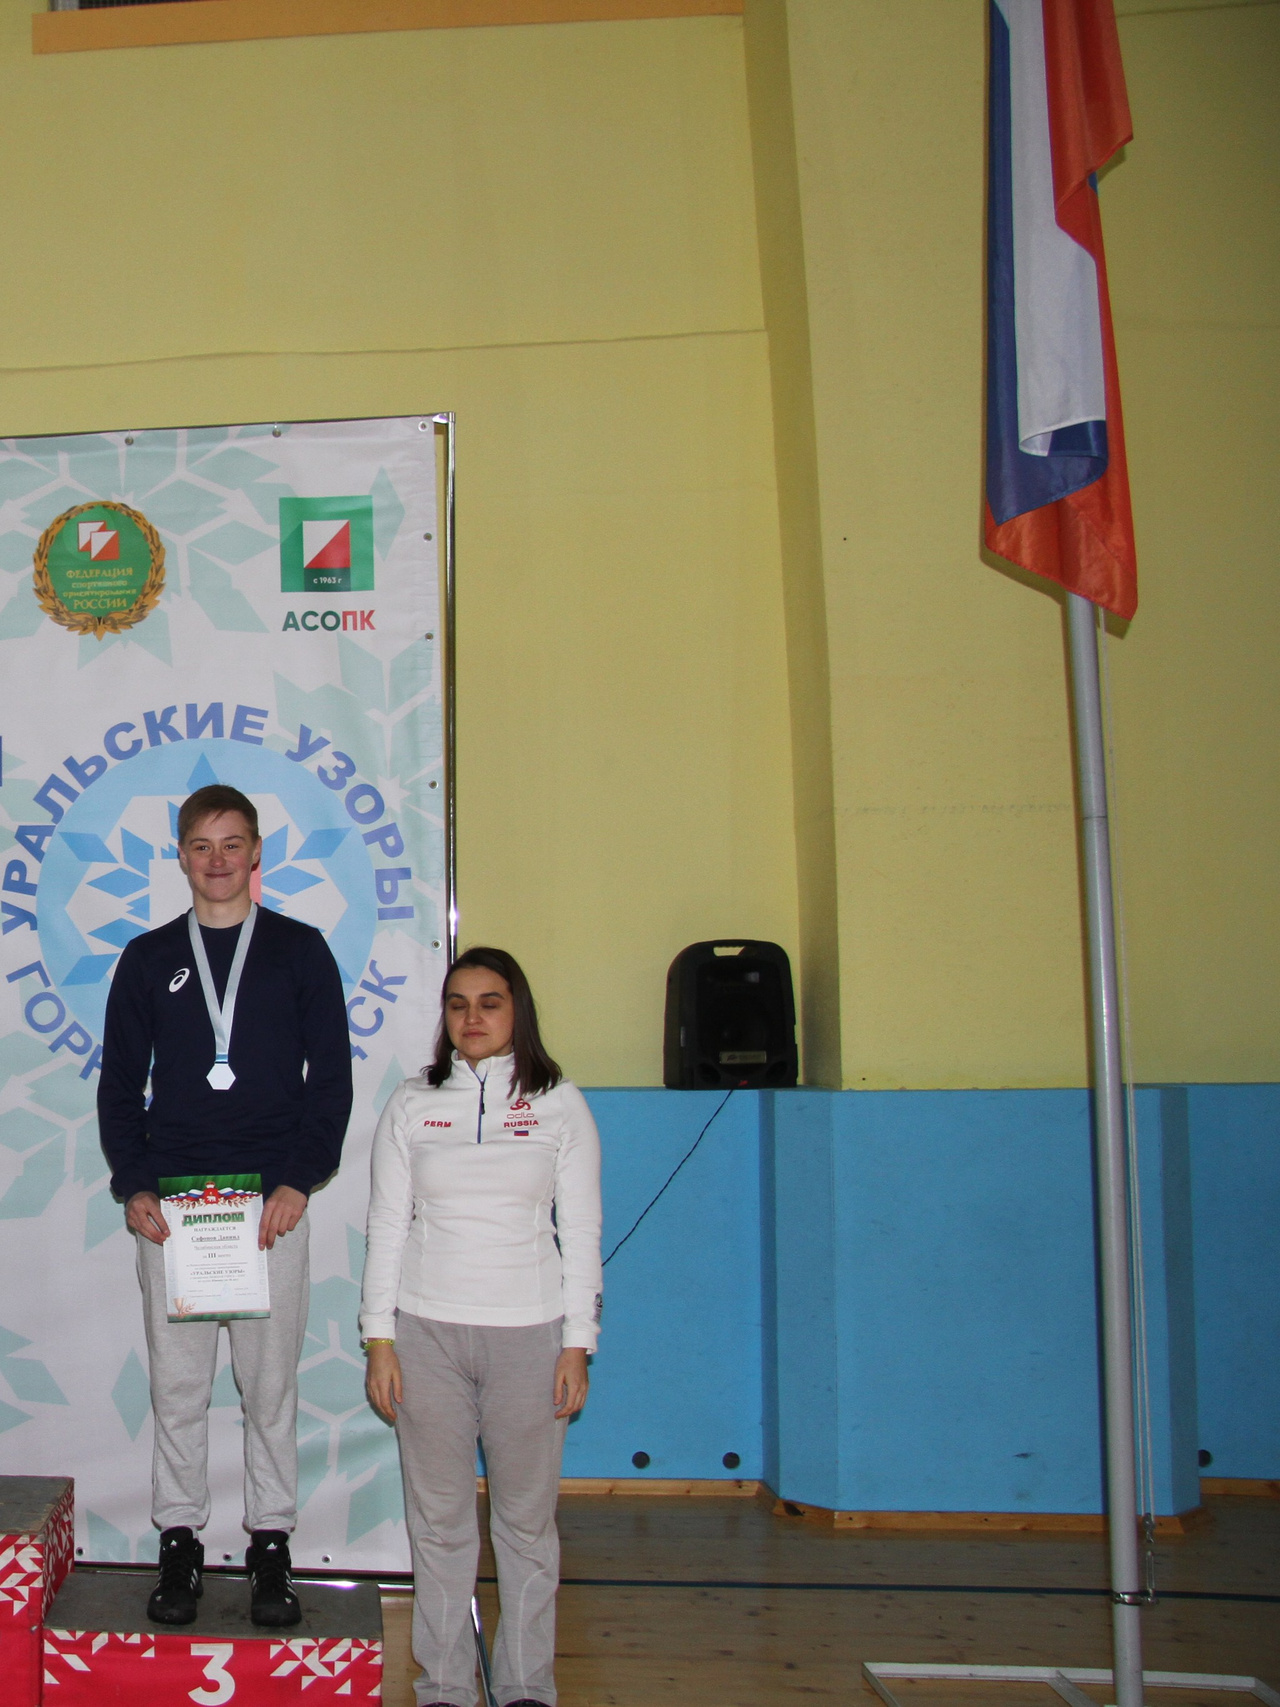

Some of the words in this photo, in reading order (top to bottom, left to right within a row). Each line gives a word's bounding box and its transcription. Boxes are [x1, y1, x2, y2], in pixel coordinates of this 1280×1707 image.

[66, 567, 133, 579] ФЕДЕРАЦИЯ
[320, 576, 337, 584] 1963
[73, 598, 127, 609] РОССИИ
[282, 610, 376, 632] АСОПК
[0, 702, 269, 936] УРАЛЬСКИЕ
[284, 723, 415, 921] УЗОРЫ
[424, 1120, 452, 1128] PERM
[504, 1120, 539, 1128] RUSSIA
[181, 1211, 245, 1227] ДИПЛОМ
[188, 1643, 236, 1706] 3
